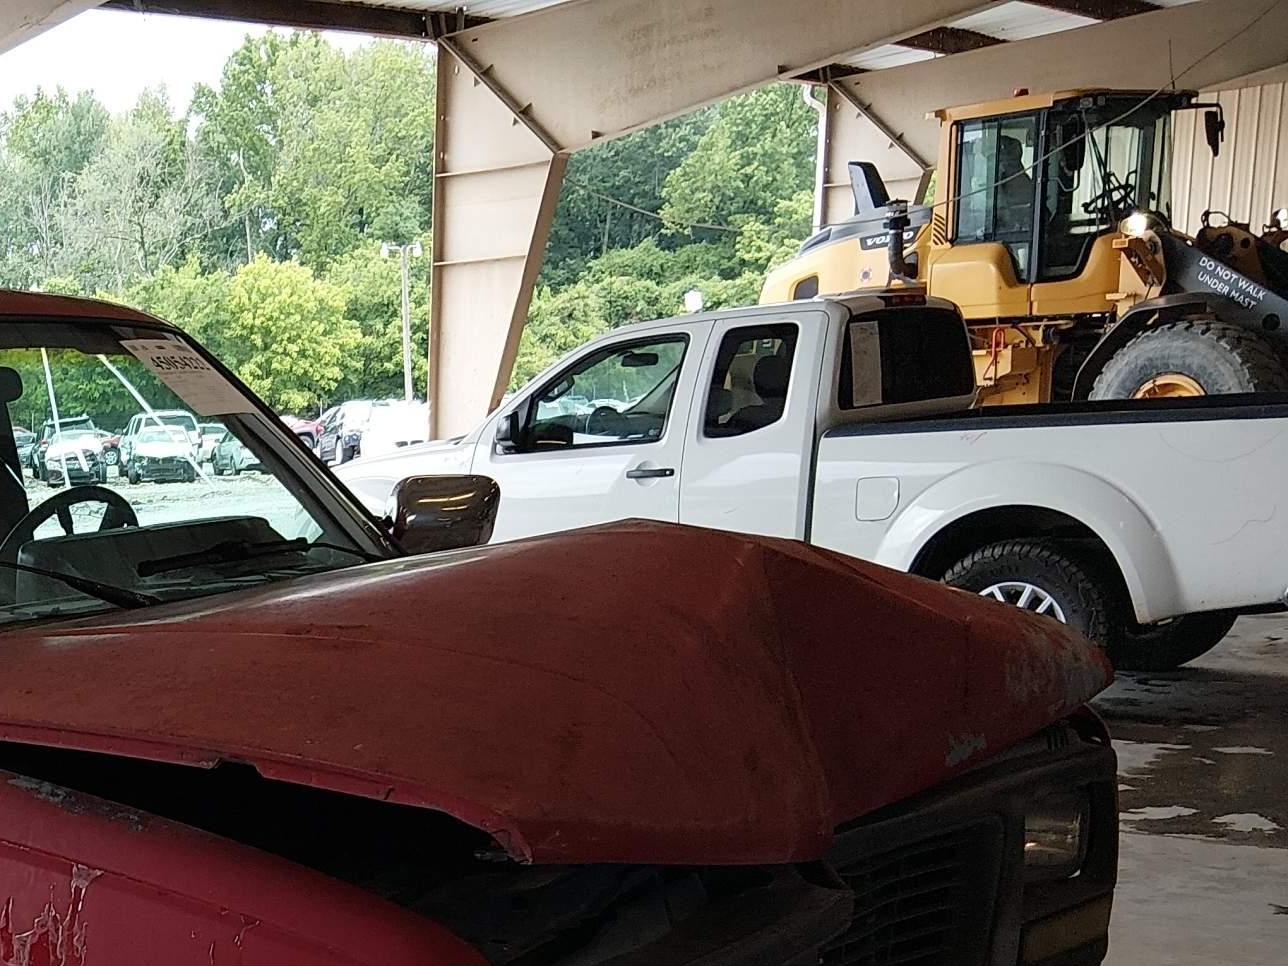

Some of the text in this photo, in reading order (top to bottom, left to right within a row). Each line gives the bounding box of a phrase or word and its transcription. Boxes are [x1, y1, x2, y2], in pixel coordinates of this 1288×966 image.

[866, 231, 914, 246] VOLO
[1198, 271, 1257, 310] UNDER MAST
[1199, 256, 1267, 301] DO NOT WALK
